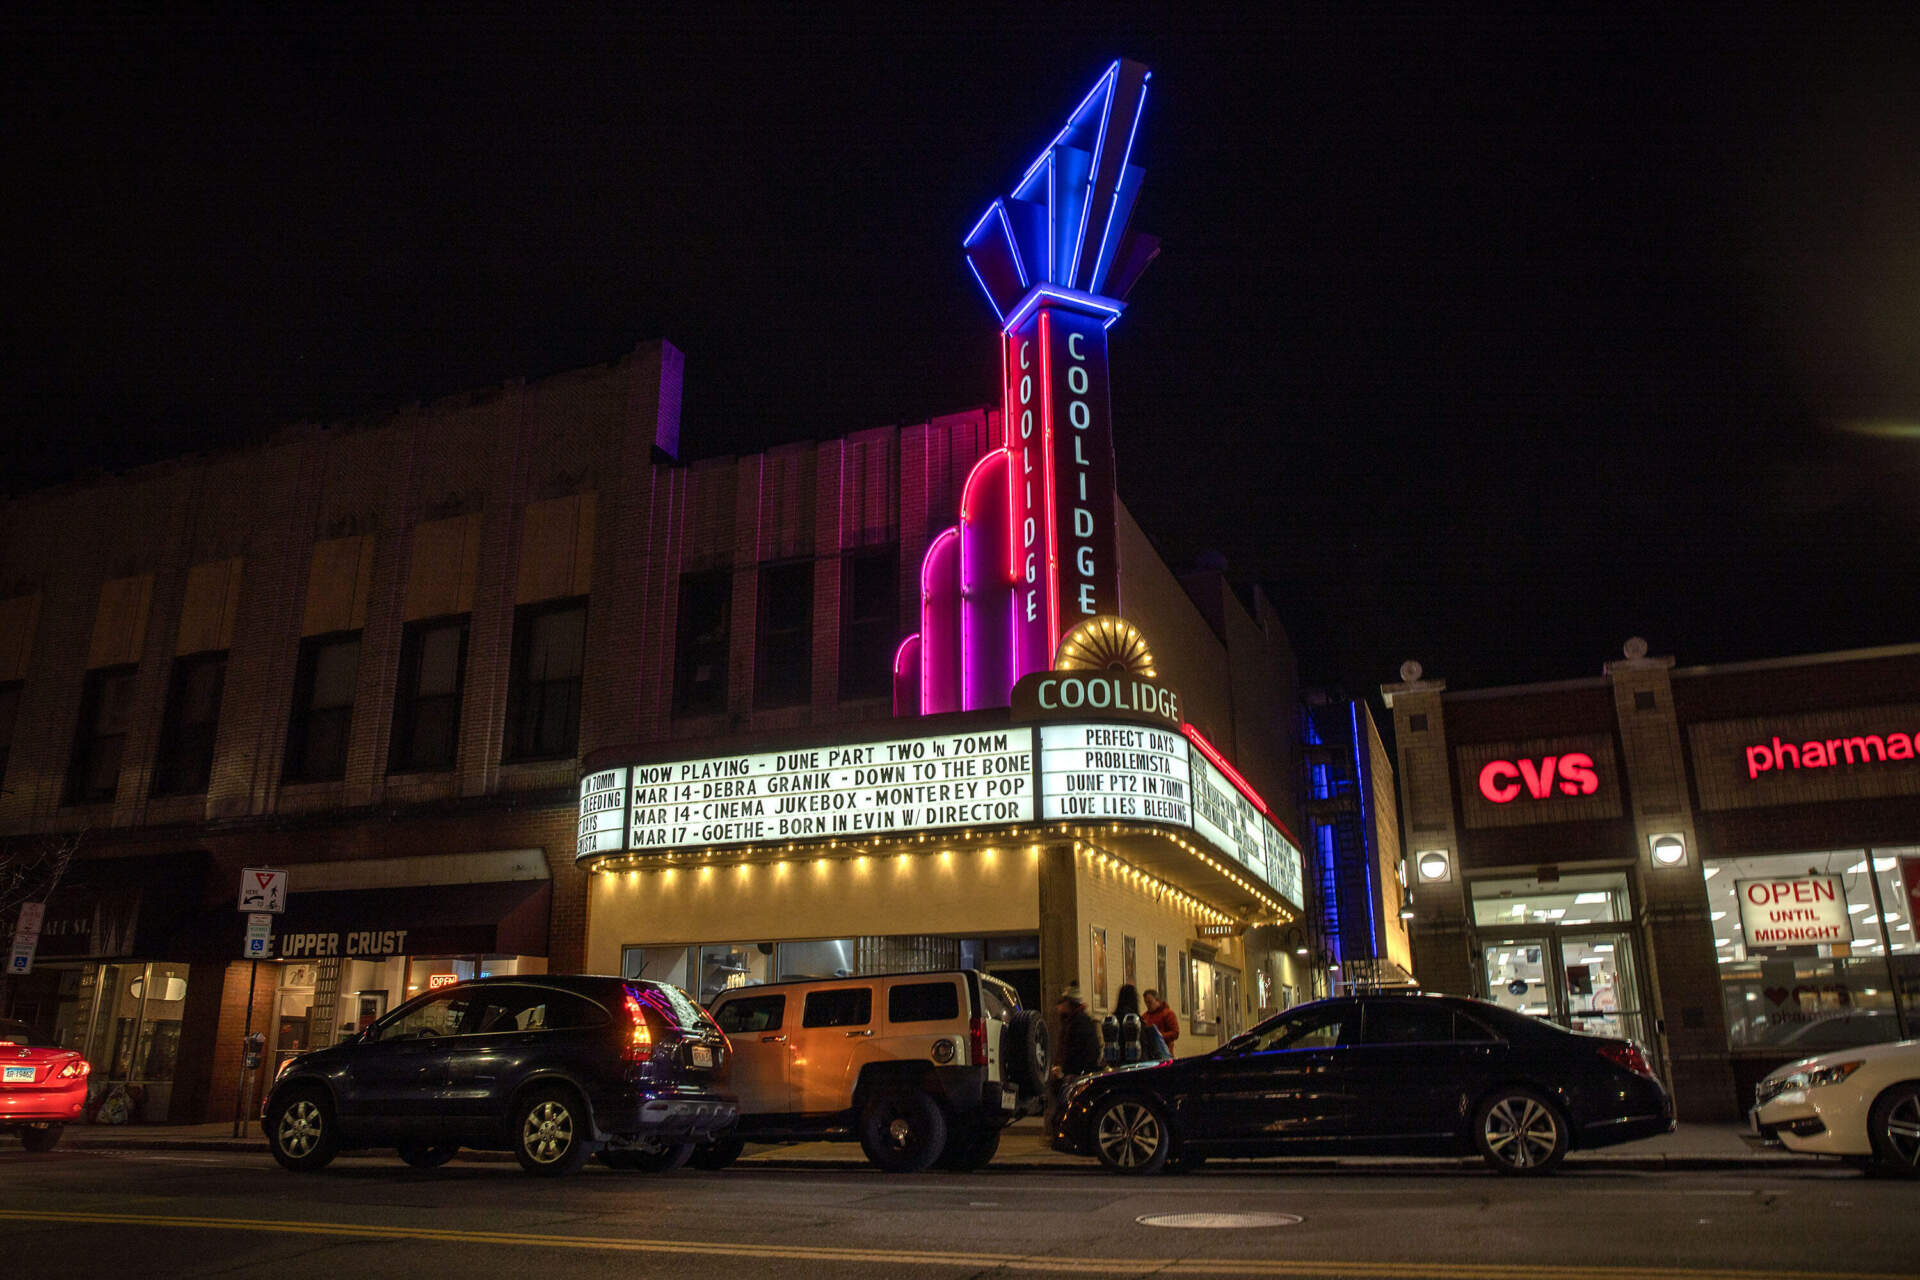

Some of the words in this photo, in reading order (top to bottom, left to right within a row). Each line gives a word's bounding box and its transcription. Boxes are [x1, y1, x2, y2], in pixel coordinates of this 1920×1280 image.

[1020, 340, 1037, 623] COOLIDGE
[1067, 332, 1096, 615] COOLIDGE
[1038, 678, 1178, 723] COOLIDGE
[640, 766, 672, 785] NOW
[682, 759, 749, 780] PLAYING
[776, 751, 819, 772] DUNE
[829, 746, 875, 767] PART
[887, 742, 925, 761] TWO
[953, 734, 1008, 755] 70MM
[1086, 729, 1144, 748] PERFECT
[1150, 732, 1175, 754] DAYS
[1746, 731, 1920, 779] pharma
[635, 788, 667, 805] MAR
[768, 773, 831, 793] GRANIK
[855, 766, 905, 786] DOWN
[913, 763, 936, 780] TO
[941, 760, 976, 778] THE
[983, 754, 1031, 775] BONE
[1085, 752, 1171, 774] PROBLEMISTA
[1479, 752, 1599, 803] CVS
[583, 791, 621, 814] BLEEDING
[634, 808, 667, 825] MAR
[774, 792, 857, 814] JUKEBOX
[876, 782, 979, 806] MONTEREY
[986, 778, 1025, 797] POP
[1067, 774, 1104, 792] DUNE
[1110, 775, 1137, 792] PT2
[1143, 777, 1157, 794] IN
[1160, 778, 1183, 799] 70MM
[633, 829, 666, 846] MAR
[672, 827, 687, 844] 17
[833, 813, 847, 832] IN
[854, 809, 895, 830] EVIN
[926, 801, 1020, 825] DIRECTOR
[1061, 797, 1096, 815] LOVE
[1103, 797, 1136, 815] LIES
[1144, 799, 1187, 823] BLEEDING
[1748, 879, 1835, 906] OPEN
[1755, 925, 1840, 942] MIDNIGHT
[1769, 909, 1820, 922] UNTIL
[282, 933, 339, 956] UPPER
[347, 930, 408, 955] CRUST
